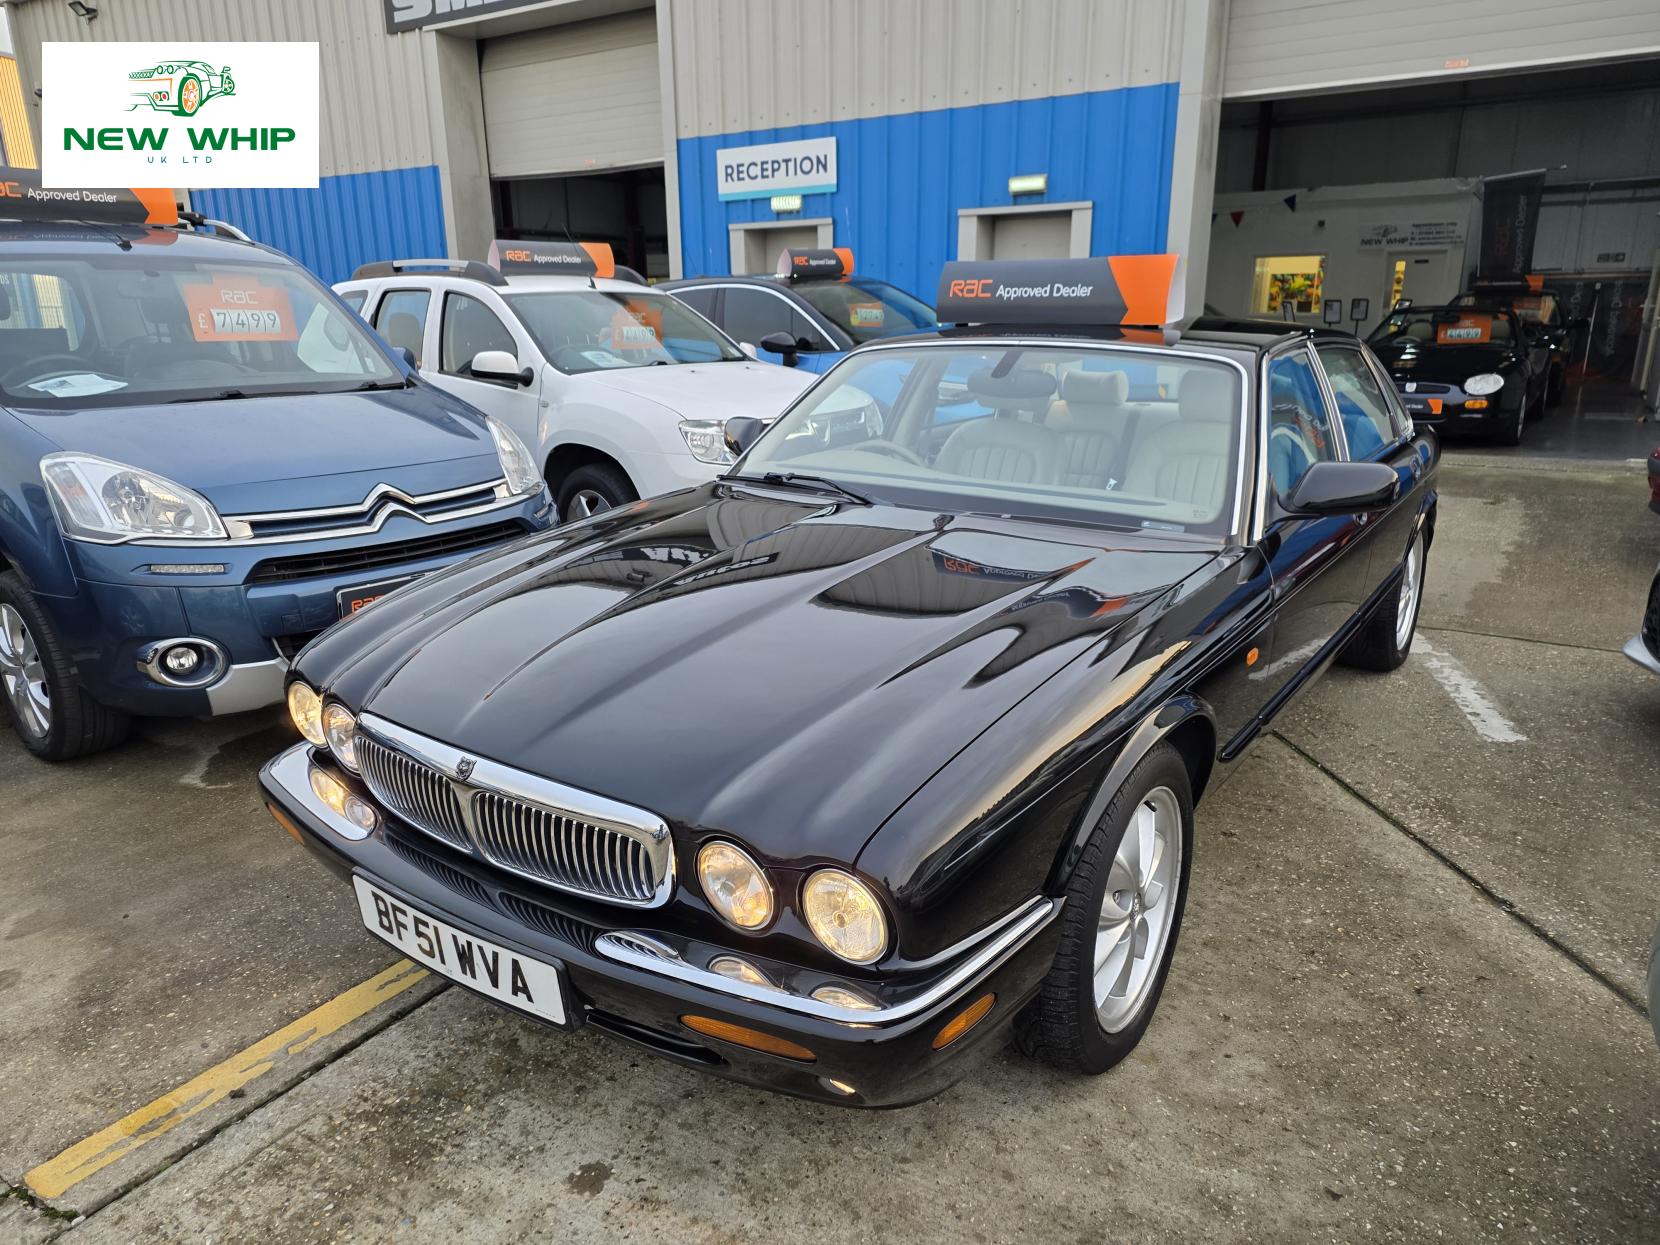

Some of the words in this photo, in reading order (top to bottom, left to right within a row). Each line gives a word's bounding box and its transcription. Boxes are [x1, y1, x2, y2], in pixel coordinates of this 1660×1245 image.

[723, 153, 828, 183] RECEPTION
[27, 187, 80, 202] Approved
[82, 190, 118, 203] Dealer
[1360, 238, 1383, 246] NEW
[1386, 236, 1409, 245] WHIP
[534, 254, 561, 264] Approved
[563, 255, 582, 264] Dealer
[995, 283, 1051, 301] Approved
[1052, 283, 1094, 298] Dealer
[216, 310, 277, 330] 7499
[370, 890, 447, 966] BF51
[450, 934, 535, 1004] WVA
